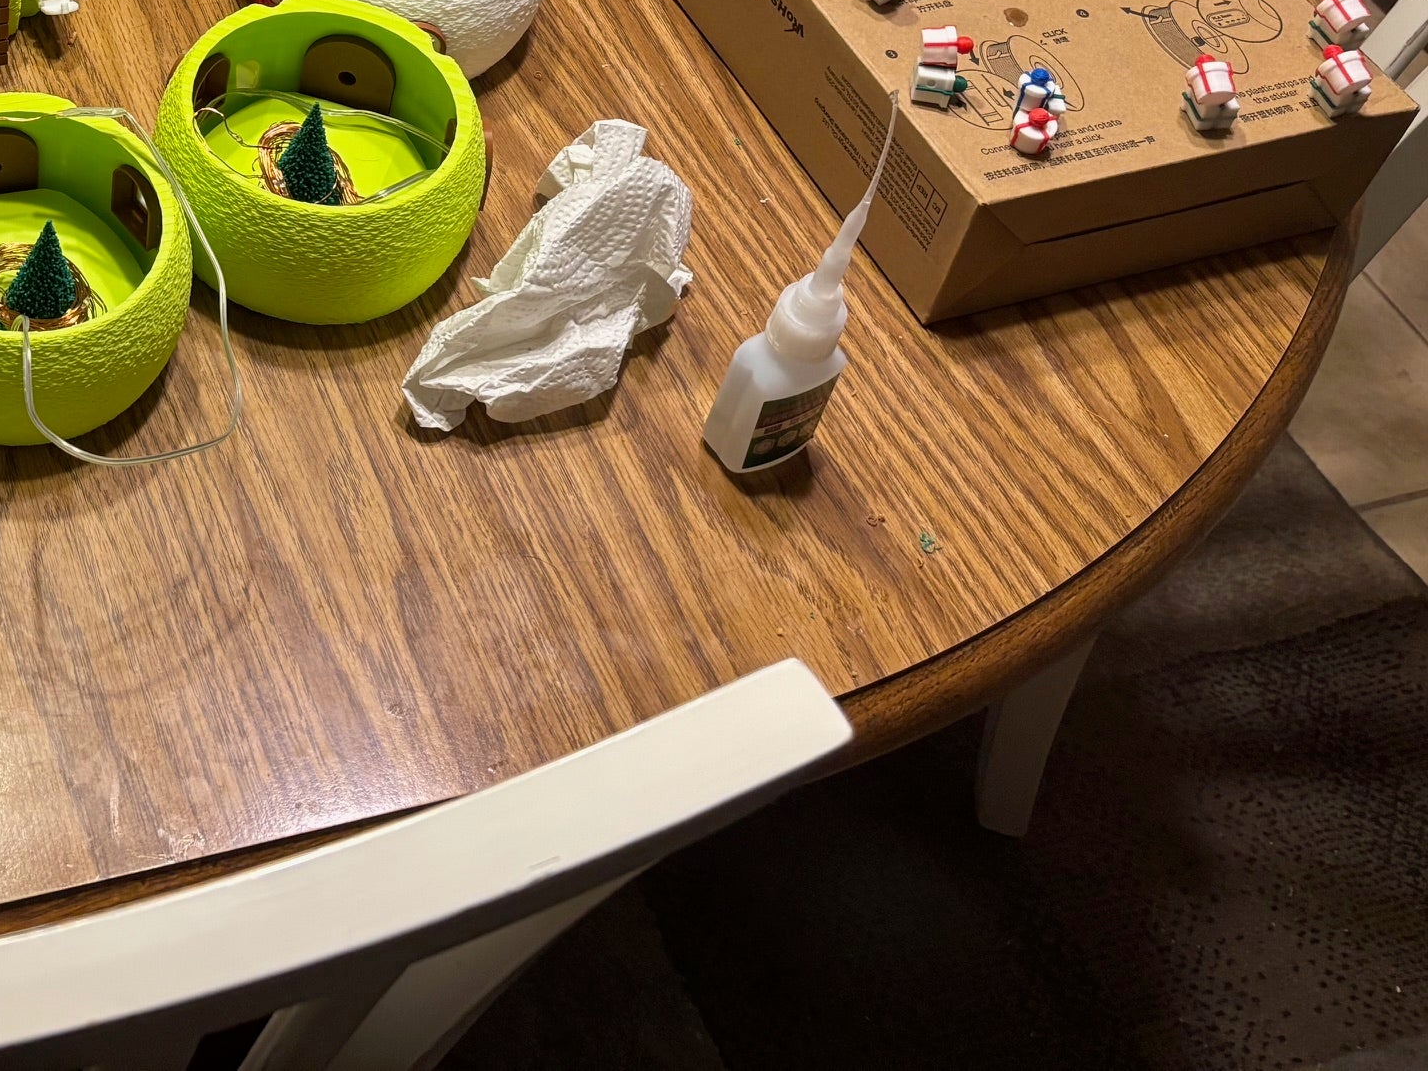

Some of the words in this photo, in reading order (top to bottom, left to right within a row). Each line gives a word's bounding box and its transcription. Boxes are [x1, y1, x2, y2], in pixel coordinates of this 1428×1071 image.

[1042, 28, 1068, 38] CLICK
[1247, 85, 1274, 98] plastic
[1274, 79, 1299, 91] strips
[1252, 96, 1270, 105] the
[1271, 90, 1299, 101] sticker
[1078, 124, 1095, 134] and
[1094, 119, 1123, 131] rotate
[1055, 140, 1075, 151] hear
[1082, 133, 1105, 144] click
